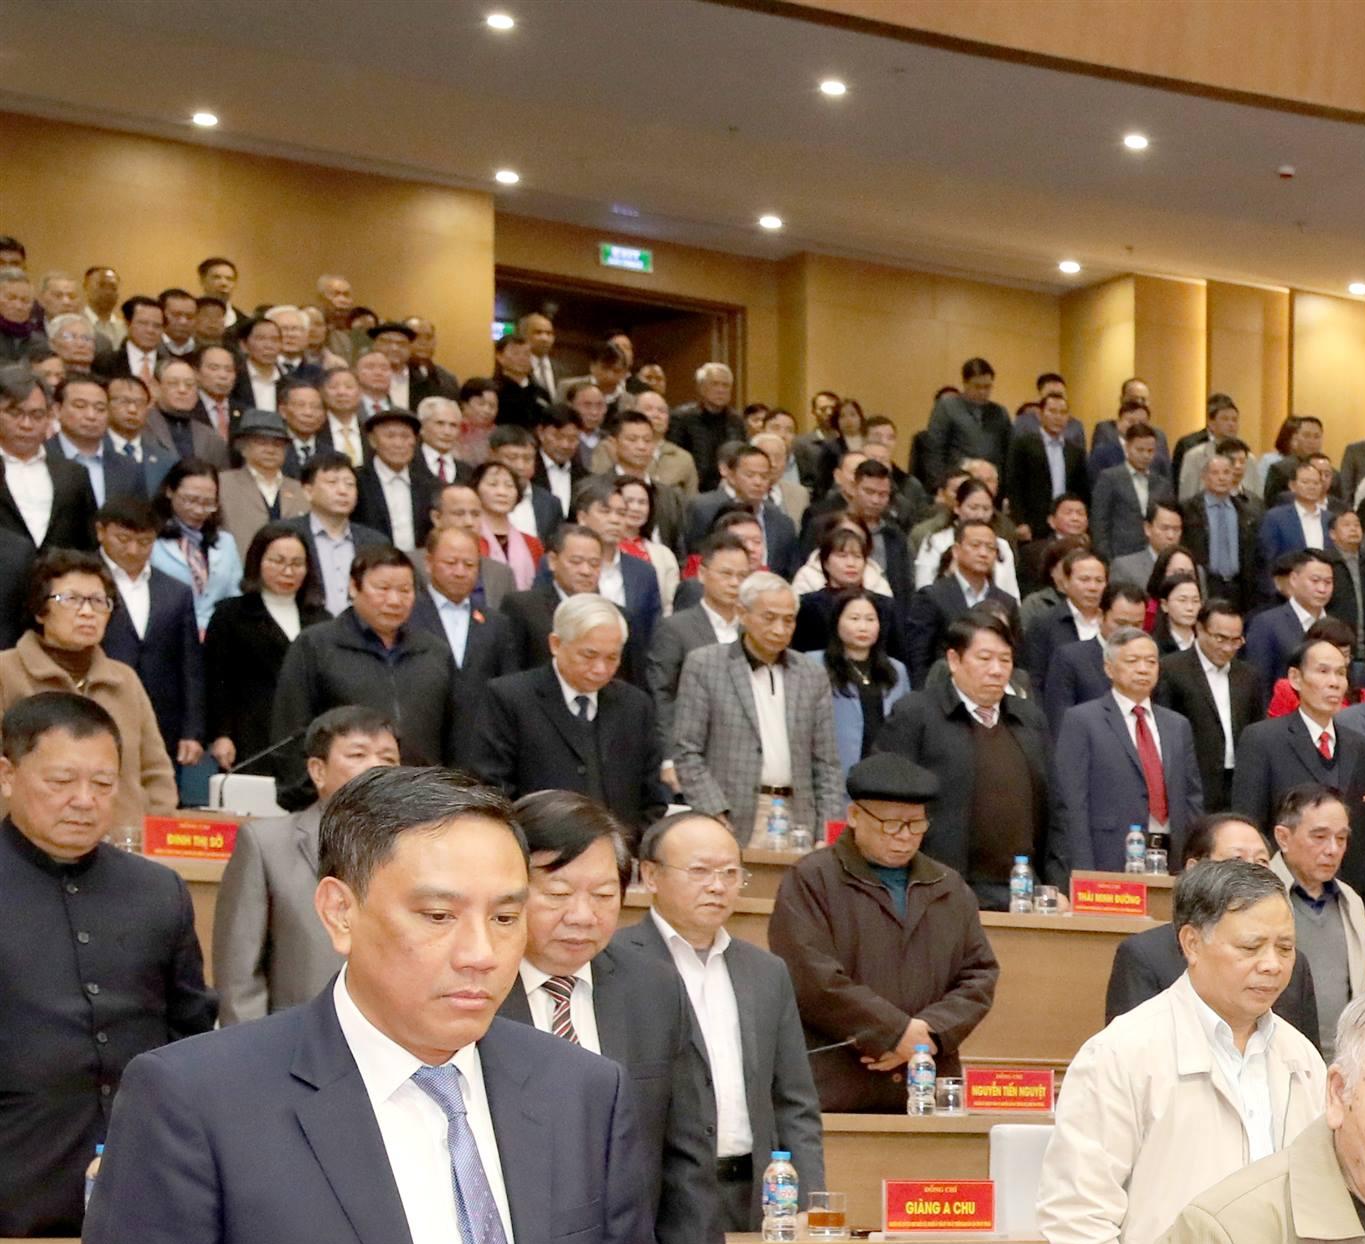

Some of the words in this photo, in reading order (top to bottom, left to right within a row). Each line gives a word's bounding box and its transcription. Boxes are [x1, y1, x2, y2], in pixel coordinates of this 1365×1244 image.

[971, 1081, 1002, 1097] NGUYỄN
[905, 1198, 940, 1215] GIÀNG
[943, 1201, 952, 1214] A
[953, 1201, 976, 1215] CHU
